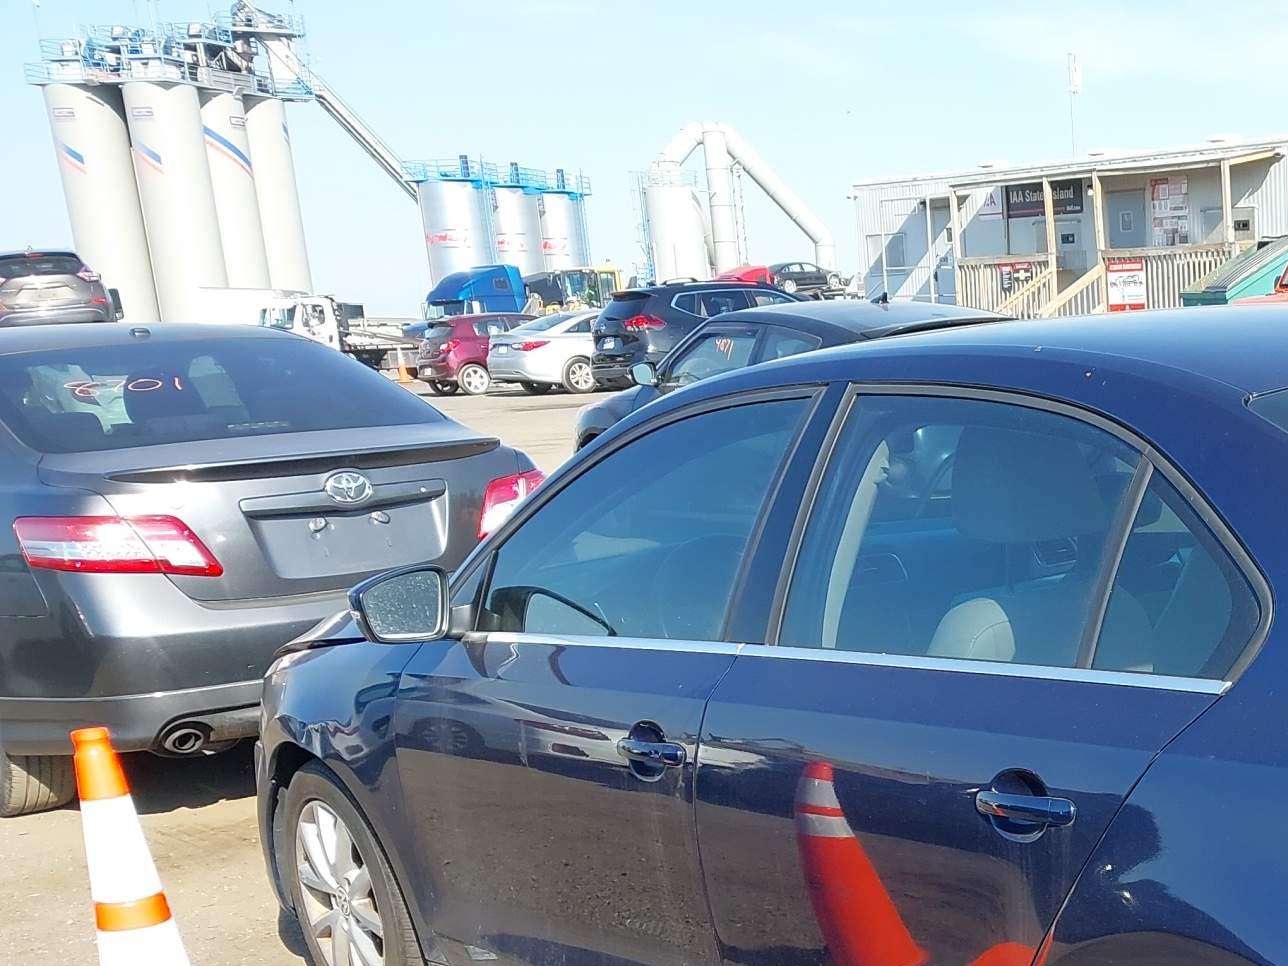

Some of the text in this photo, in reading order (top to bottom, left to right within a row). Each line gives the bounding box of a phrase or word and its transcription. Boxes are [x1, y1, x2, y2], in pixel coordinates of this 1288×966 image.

[1009, 185, 1074, 204] IAA State sland
